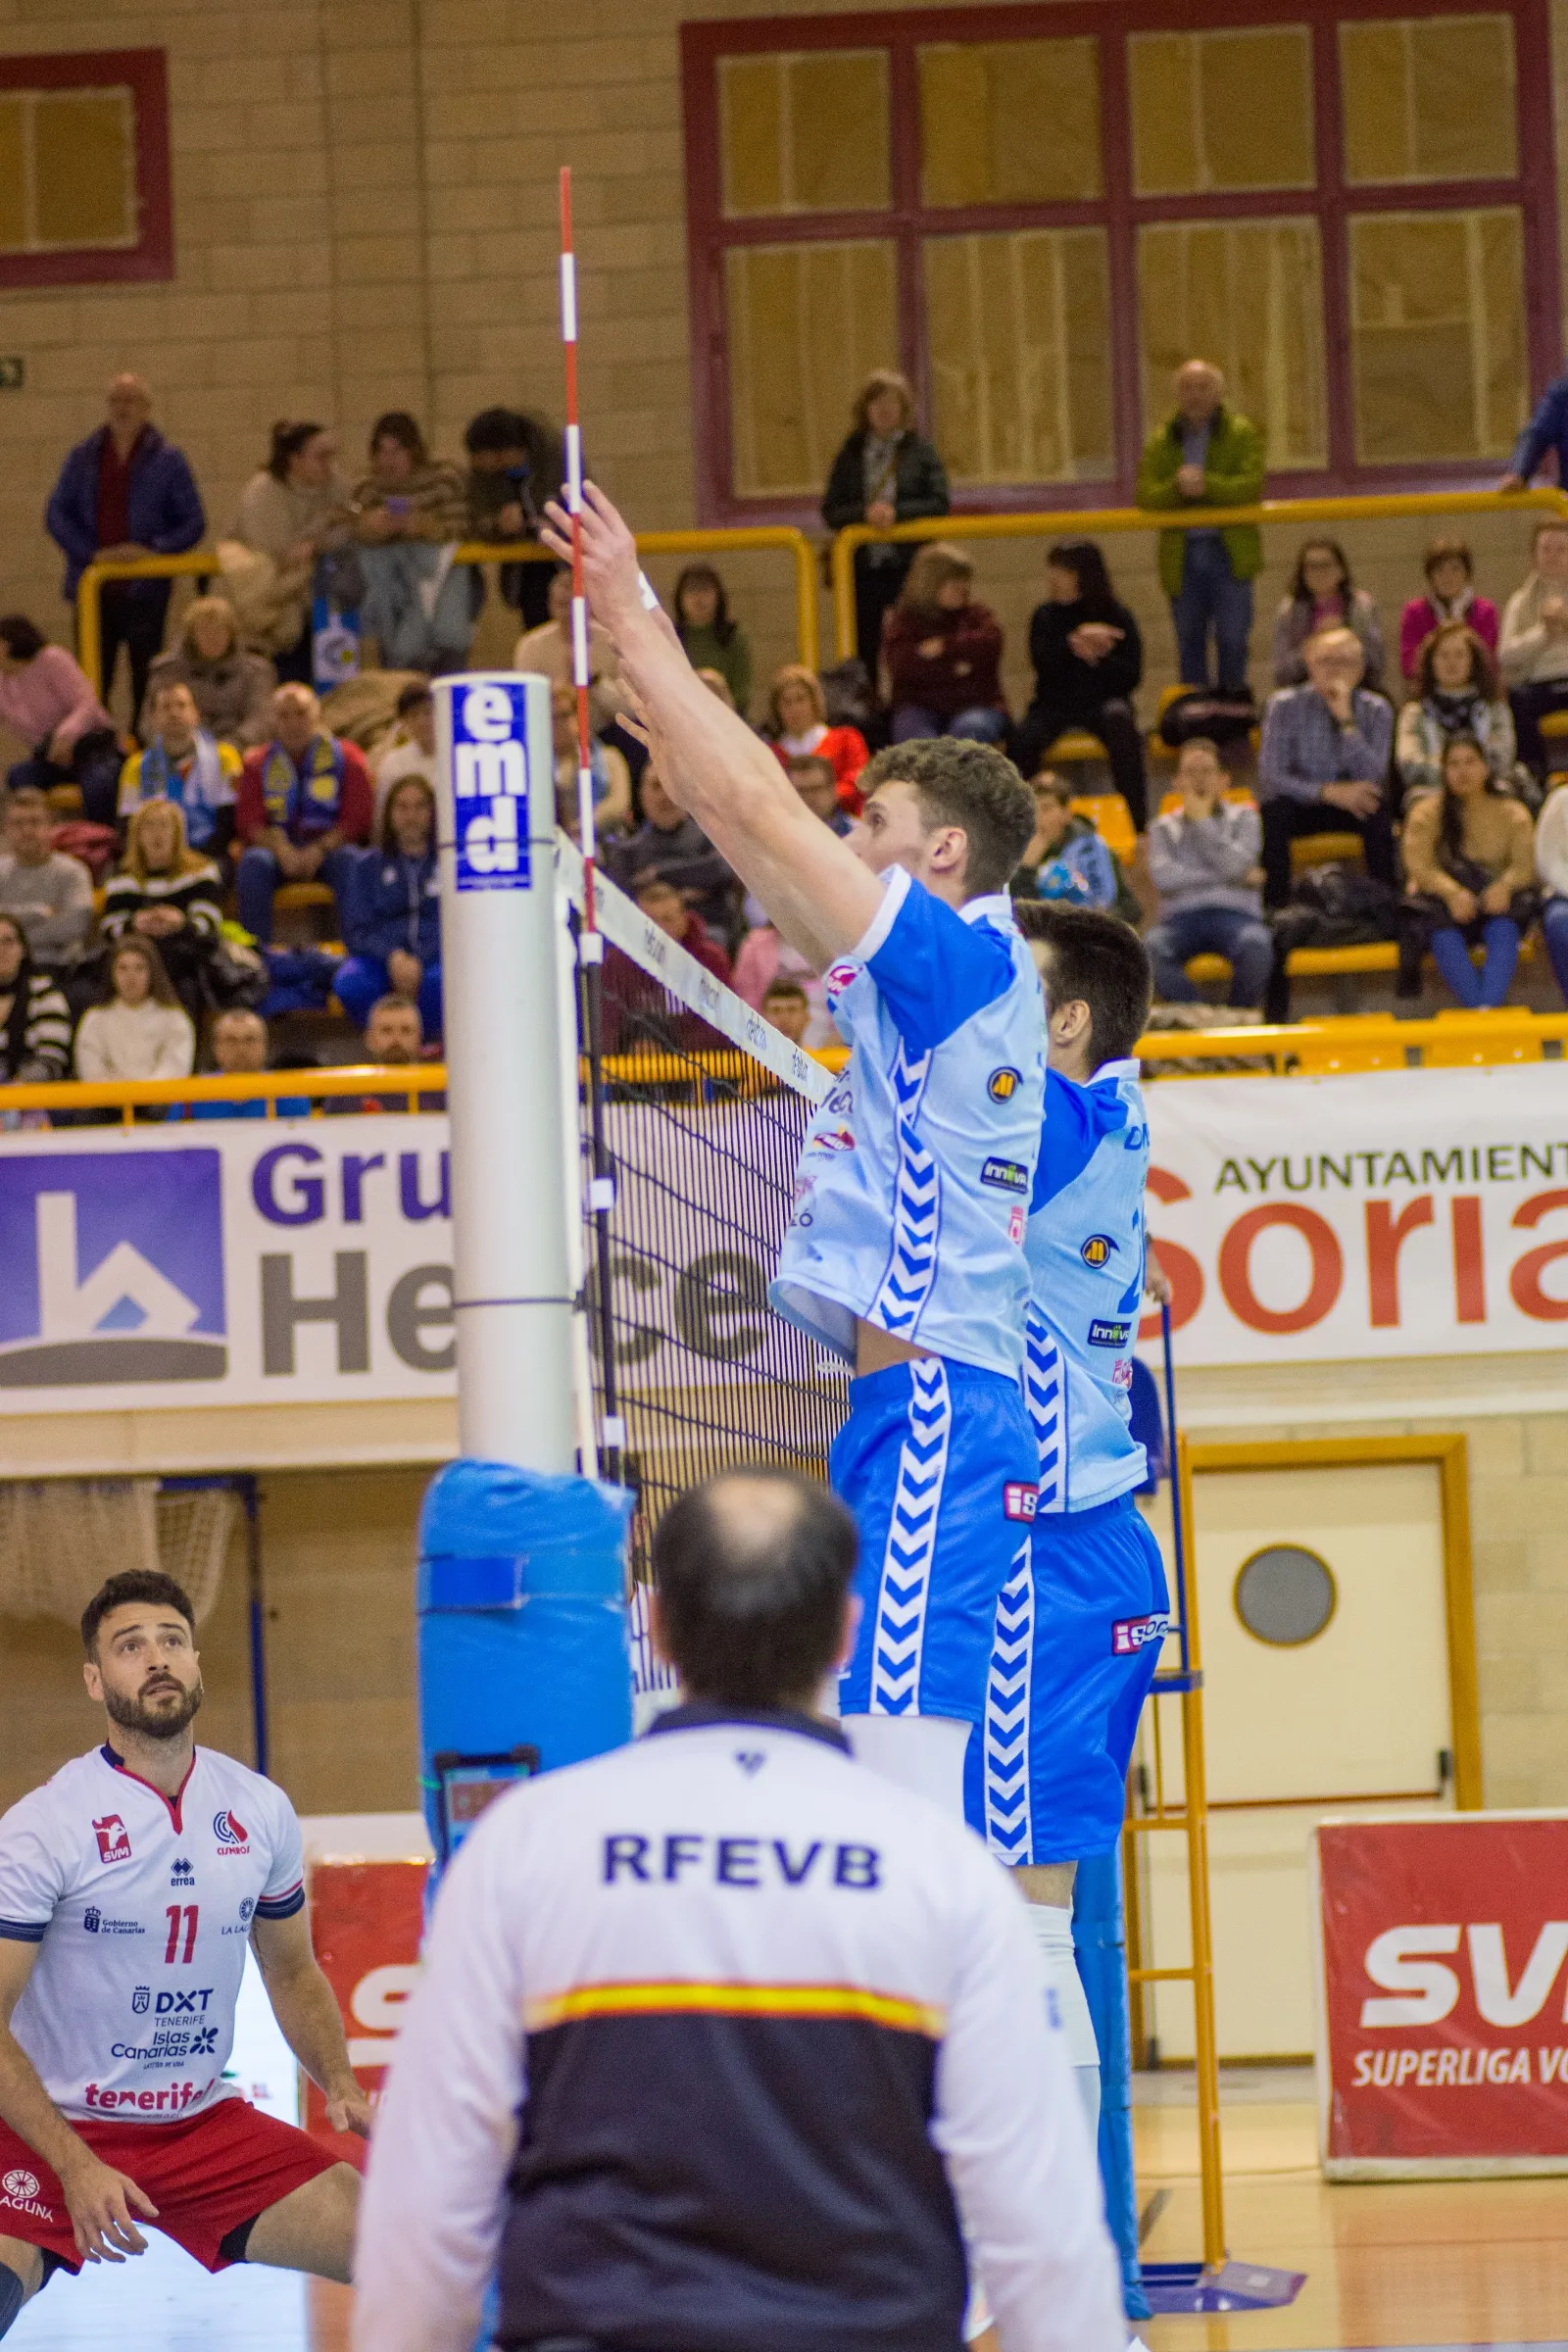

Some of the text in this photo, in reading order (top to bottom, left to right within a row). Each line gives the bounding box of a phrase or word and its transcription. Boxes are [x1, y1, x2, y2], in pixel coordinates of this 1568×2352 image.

[456, 685, 526, 874] emd
[251, 1143, 452, 1225] Gru
[103, 1846, 129, 1863] SVM
[602, 1834, 880, 1889] RFEVB
[102, 1919, 138, 1928] Gobierno
[165, 1905, 199, 1964] 11
[1359, 1922, 1568, 2029] SV
[155, 1988, 214, 2013] DXT
[154, 2015, 206, 2028] TENERIFE
[111, 2042, 187, 2060] Canarias
[153, 2031, 190, 2045] Islas
[1351, 2046, 1531, 2087] SUPERLIGA
[0, 2195, 54, 2223] AGUNA
